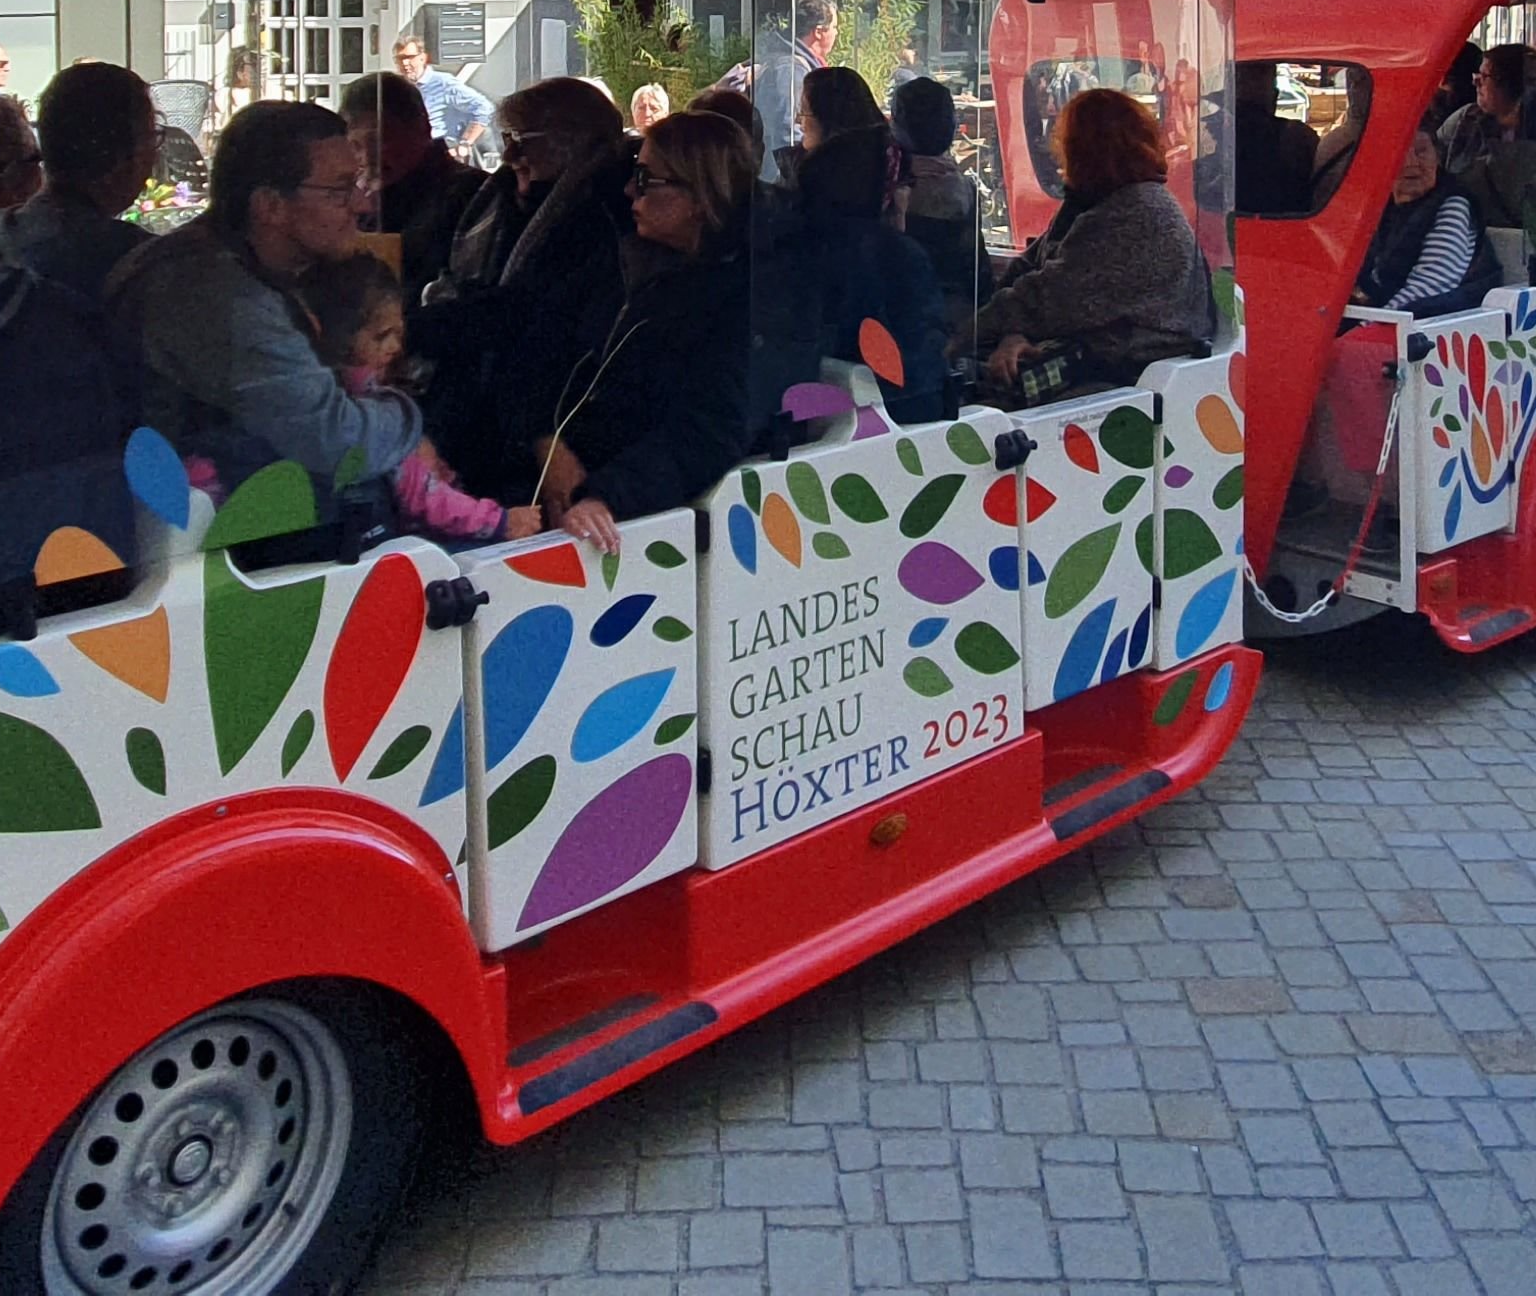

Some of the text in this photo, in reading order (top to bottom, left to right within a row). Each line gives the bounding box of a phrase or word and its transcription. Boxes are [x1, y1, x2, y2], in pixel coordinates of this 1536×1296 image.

[728, 575, 880, 663] LANDES
[729, 628, 886, 720] GARTEN
[730, 693, 1009, 844] HÖXTER 2023
[731, 692, 863, 783] SCHAU
